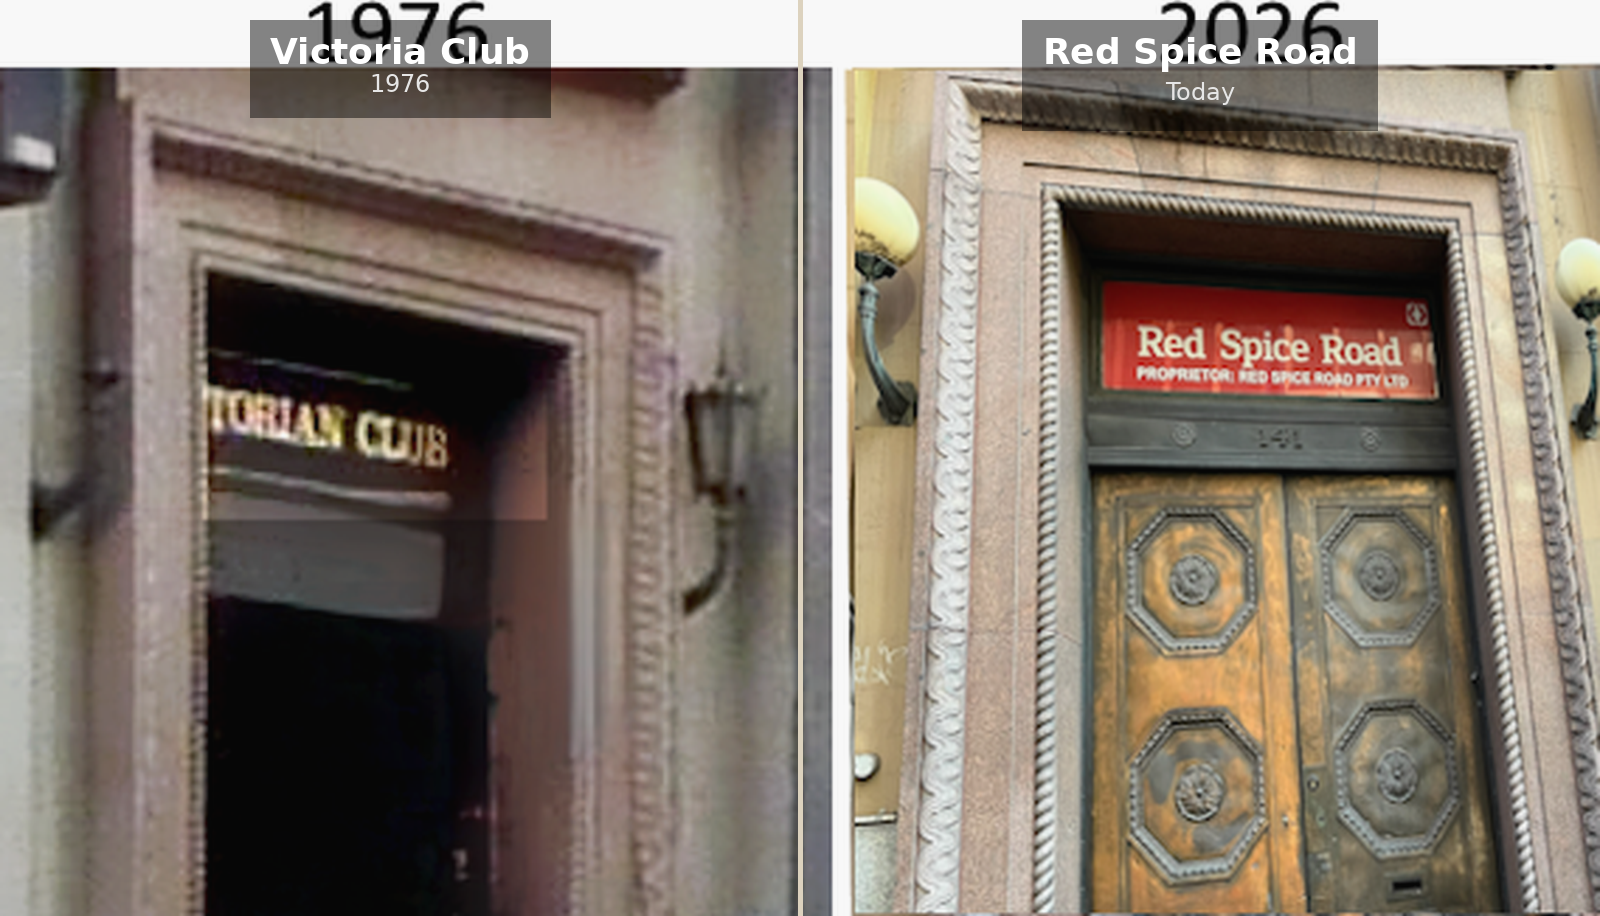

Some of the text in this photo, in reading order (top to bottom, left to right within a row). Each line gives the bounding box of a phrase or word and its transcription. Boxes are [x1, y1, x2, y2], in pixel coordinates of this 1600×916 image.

[1137, 325, 1403, 368] Red Spice Road
[1136, 366, 1409, 388] PROPRIETOR: RED SPICE ROAD PTY LTD
[357, 411, 448, 468] CLUB
[1258, 428, 1303, 450] 141
